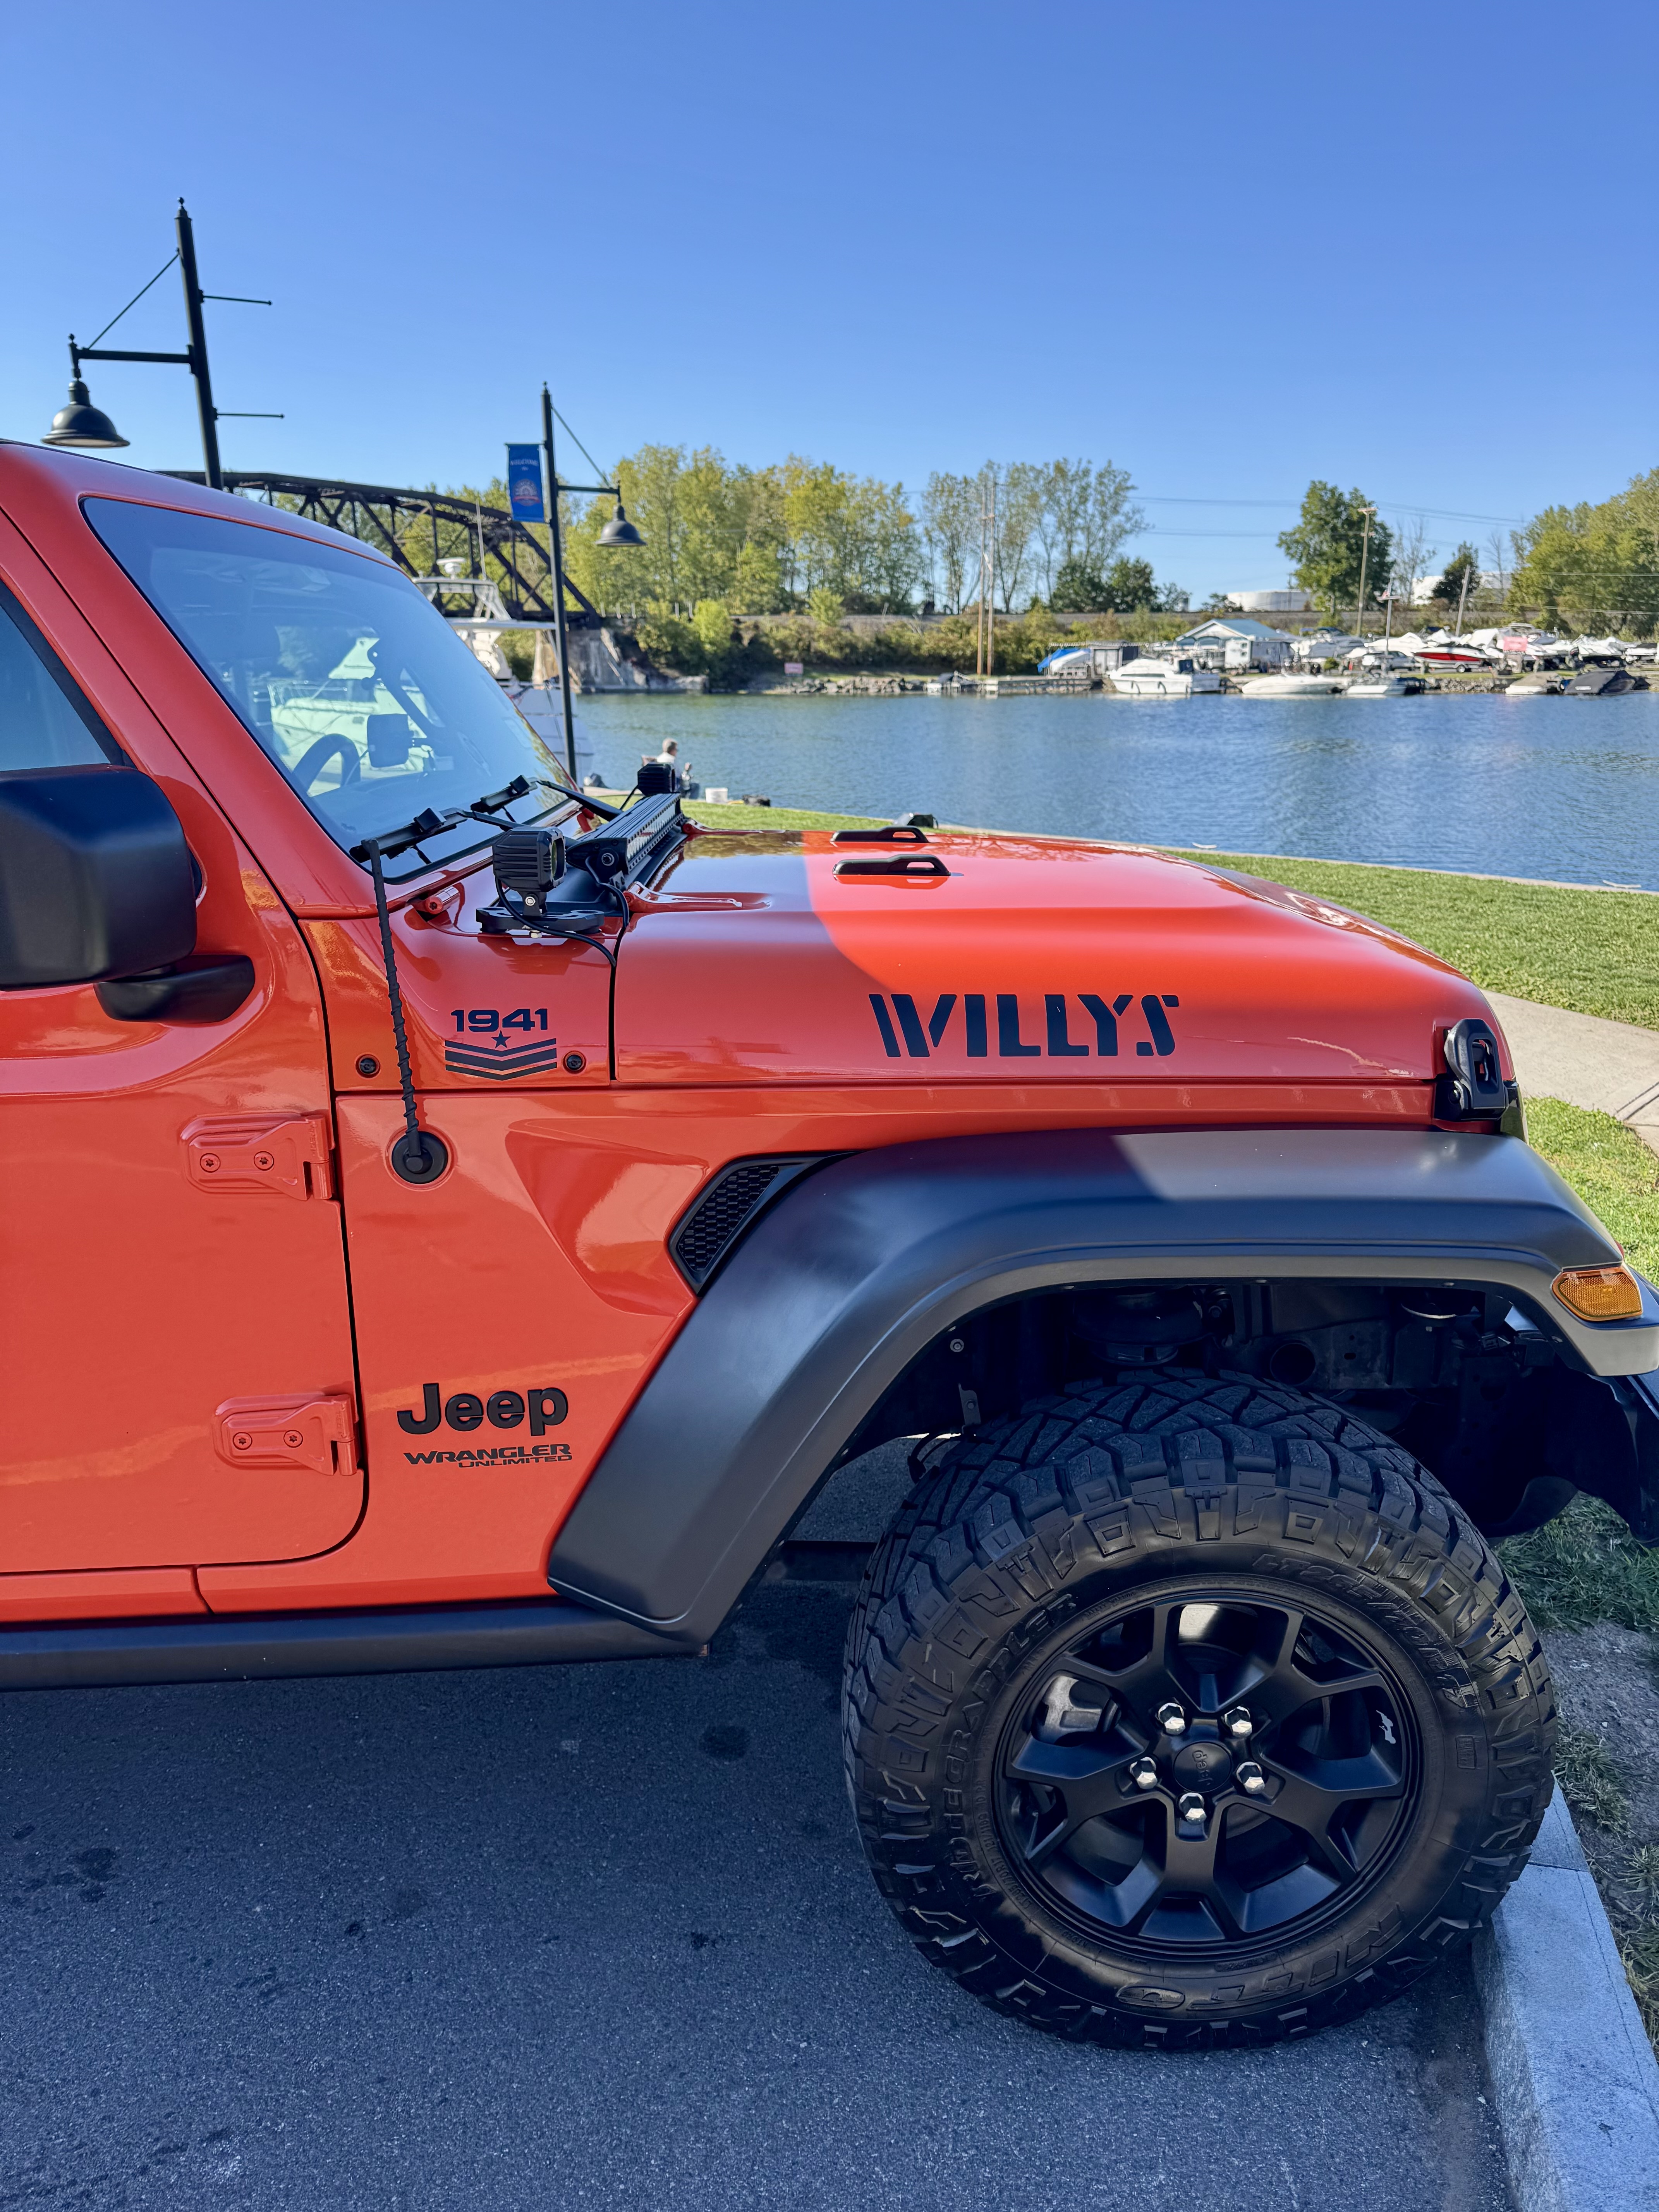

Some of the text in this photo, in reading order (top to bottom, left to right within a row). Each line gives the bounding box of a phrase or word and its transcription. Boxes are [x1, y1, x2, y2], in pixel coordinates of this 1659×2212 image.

[450, 1008, 548, 1032] 1941
[868, 994, 1180, 1057] WILLYS
[397, 1382, 569, 1436] Jeep
[403, 1443, 572, 1465] WRANGLER
[459, 1455, 572, 1468] UNLIMITED
[945, 1593, 1077, 1784] GRAPPLER
[1192, 1750, 1214, 1786] Jeep
[1115, 1903, 1403, 2011] NITTO
